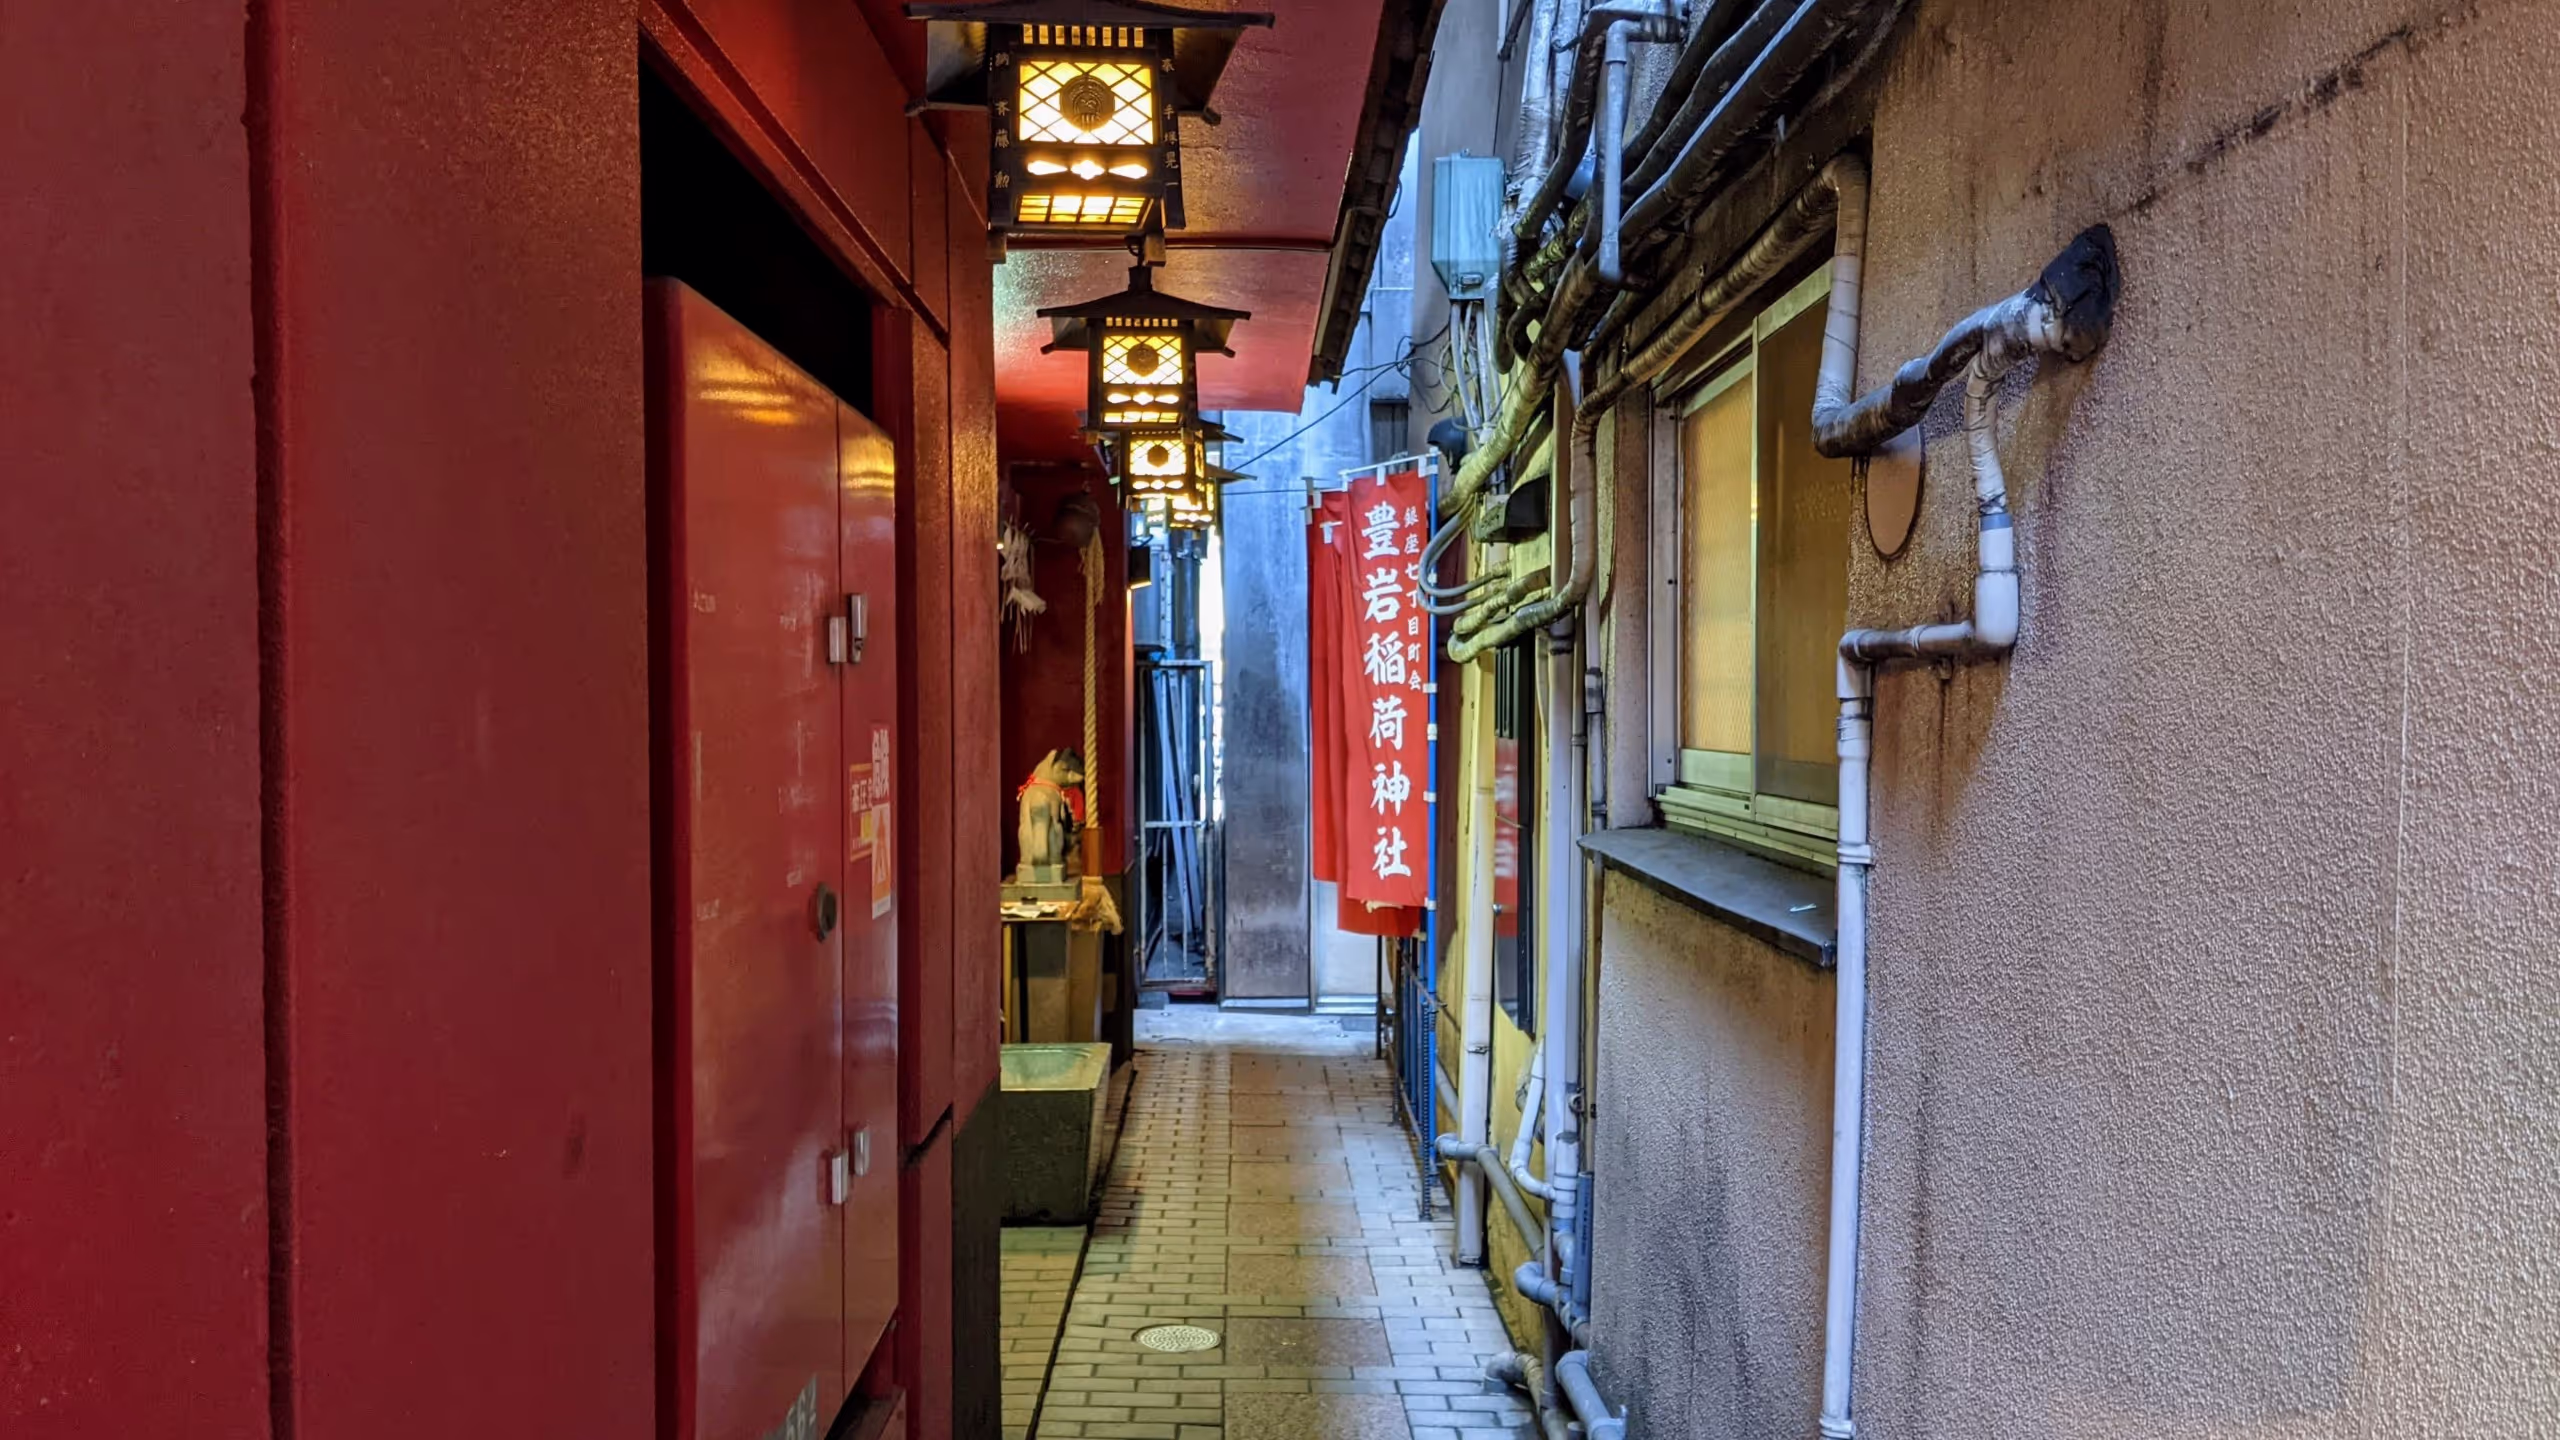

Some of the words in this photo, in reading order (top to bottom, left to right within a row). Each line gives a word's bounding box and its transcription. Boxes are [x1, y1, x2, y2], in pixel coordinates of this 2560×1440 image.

[1361, 500, 1412, 881] 豊岩稲荷神社
[1403, 505, 1422, 692] 銀座七丁目町会
